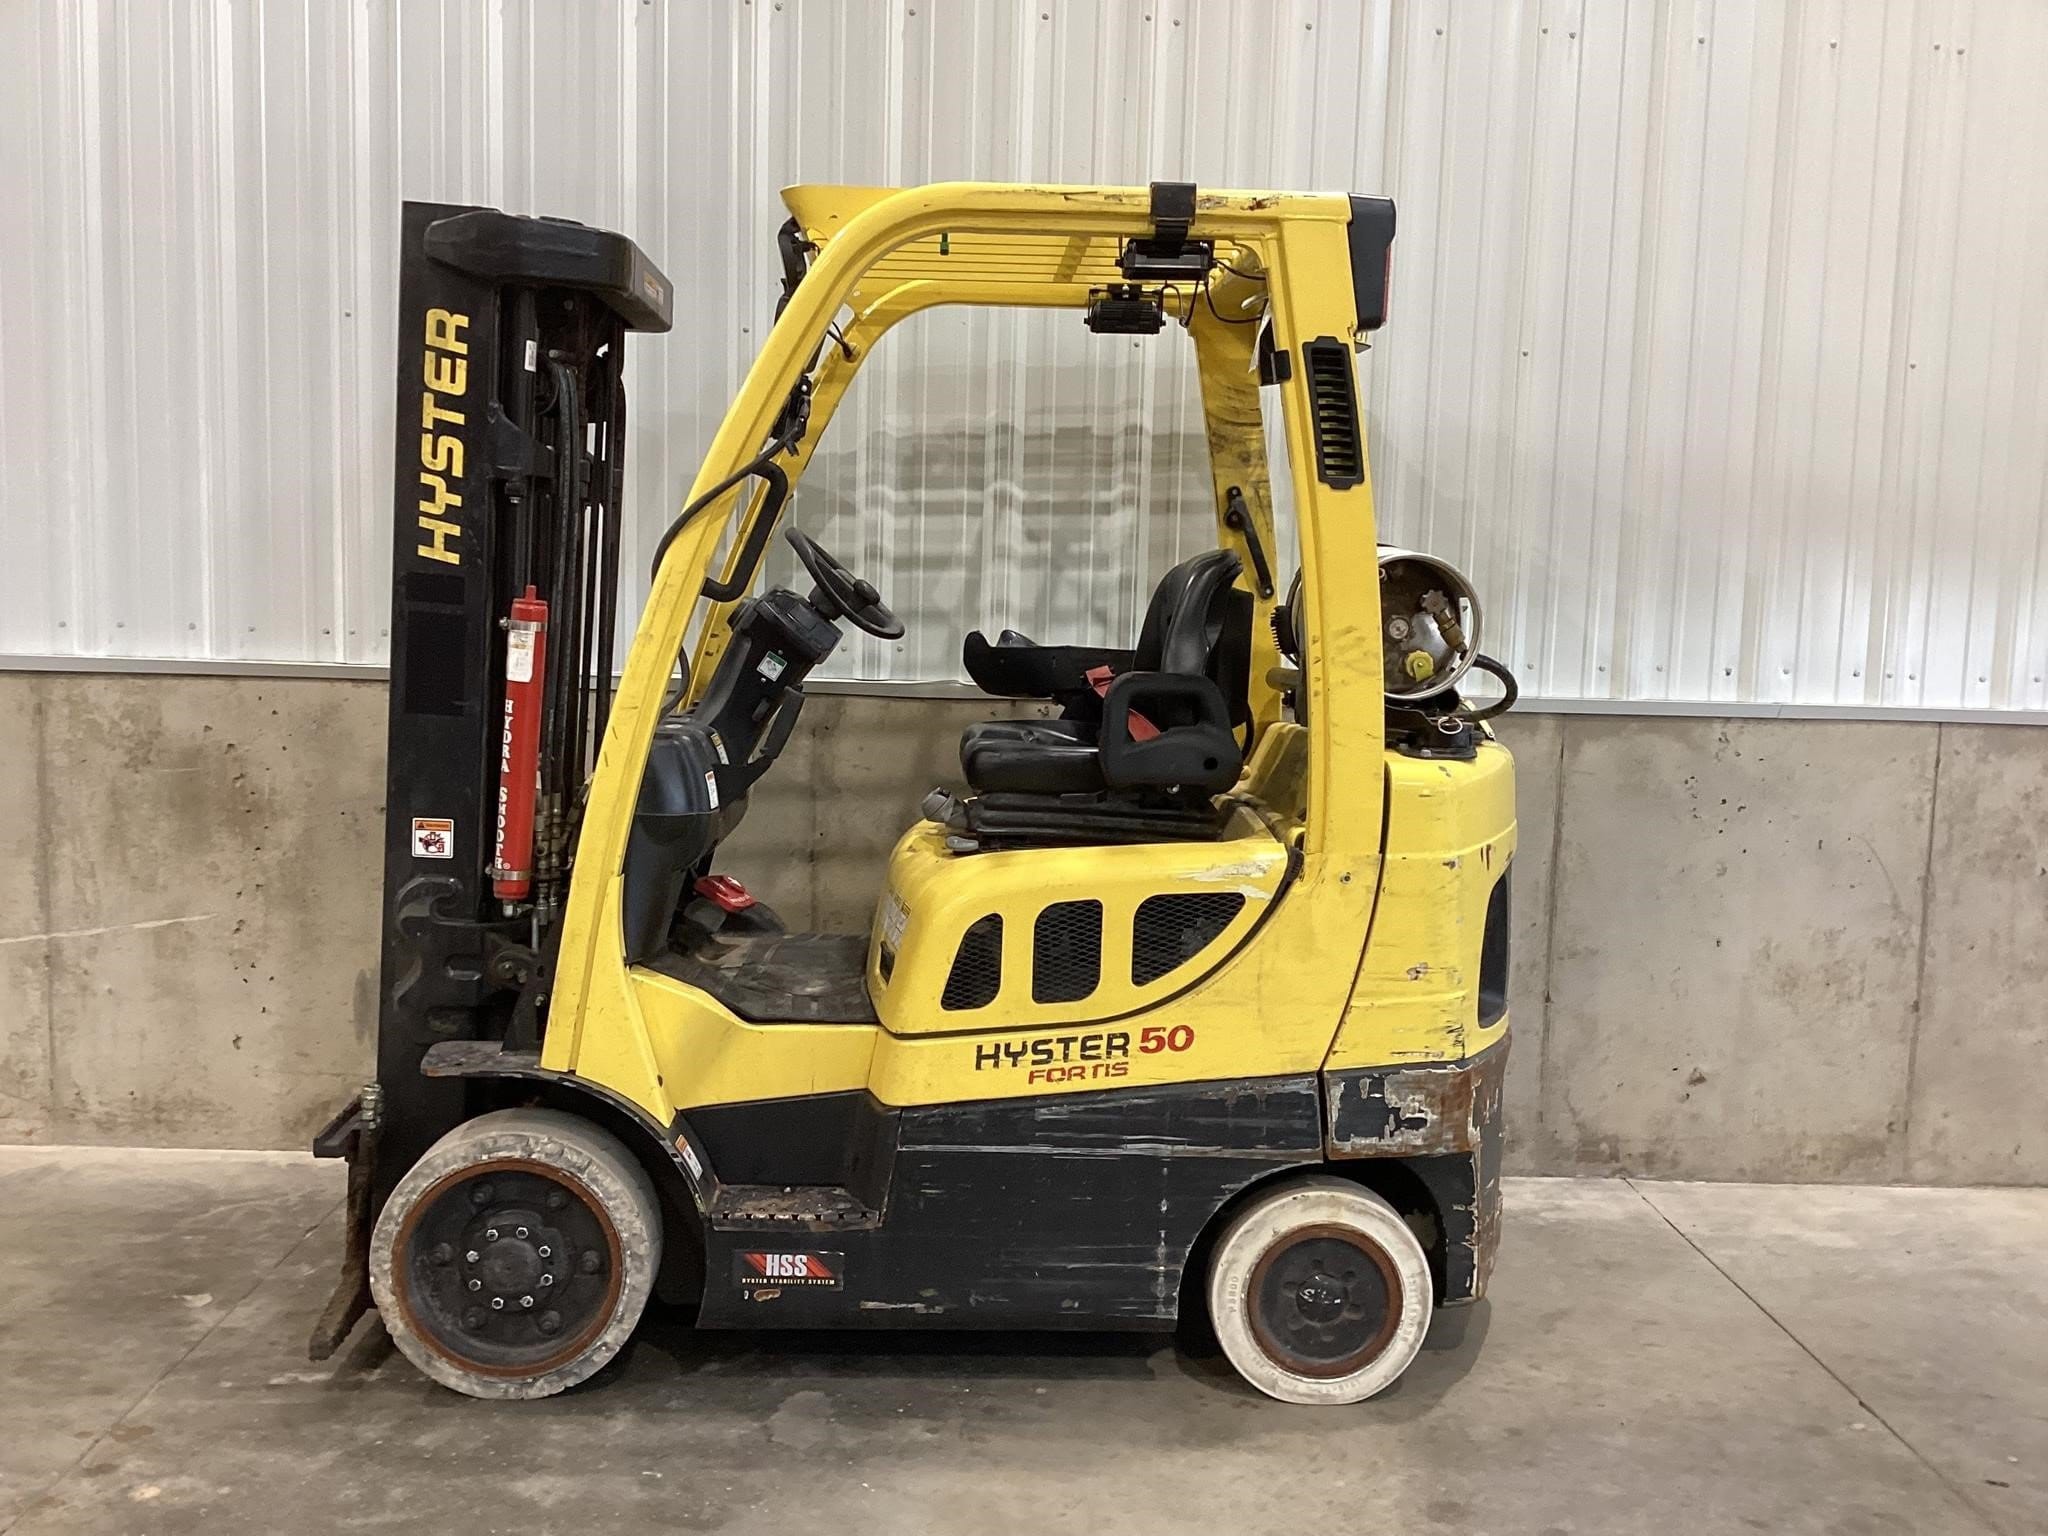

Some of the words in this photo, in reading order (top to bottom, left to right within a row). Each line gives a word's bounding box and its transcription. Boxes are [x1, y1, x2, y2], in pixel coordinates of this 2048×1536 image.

[417, 308, 469, 565] HYSTER
[501, 699, 514, 773] HYDRA
[975, 1032, 1130, 1071] HYSTER
[1139, 1025, 1195, 1054] 50
[1028, 1062, 1129, 1085] FORTIS
[765, 1254, 808, 1277] HSS
